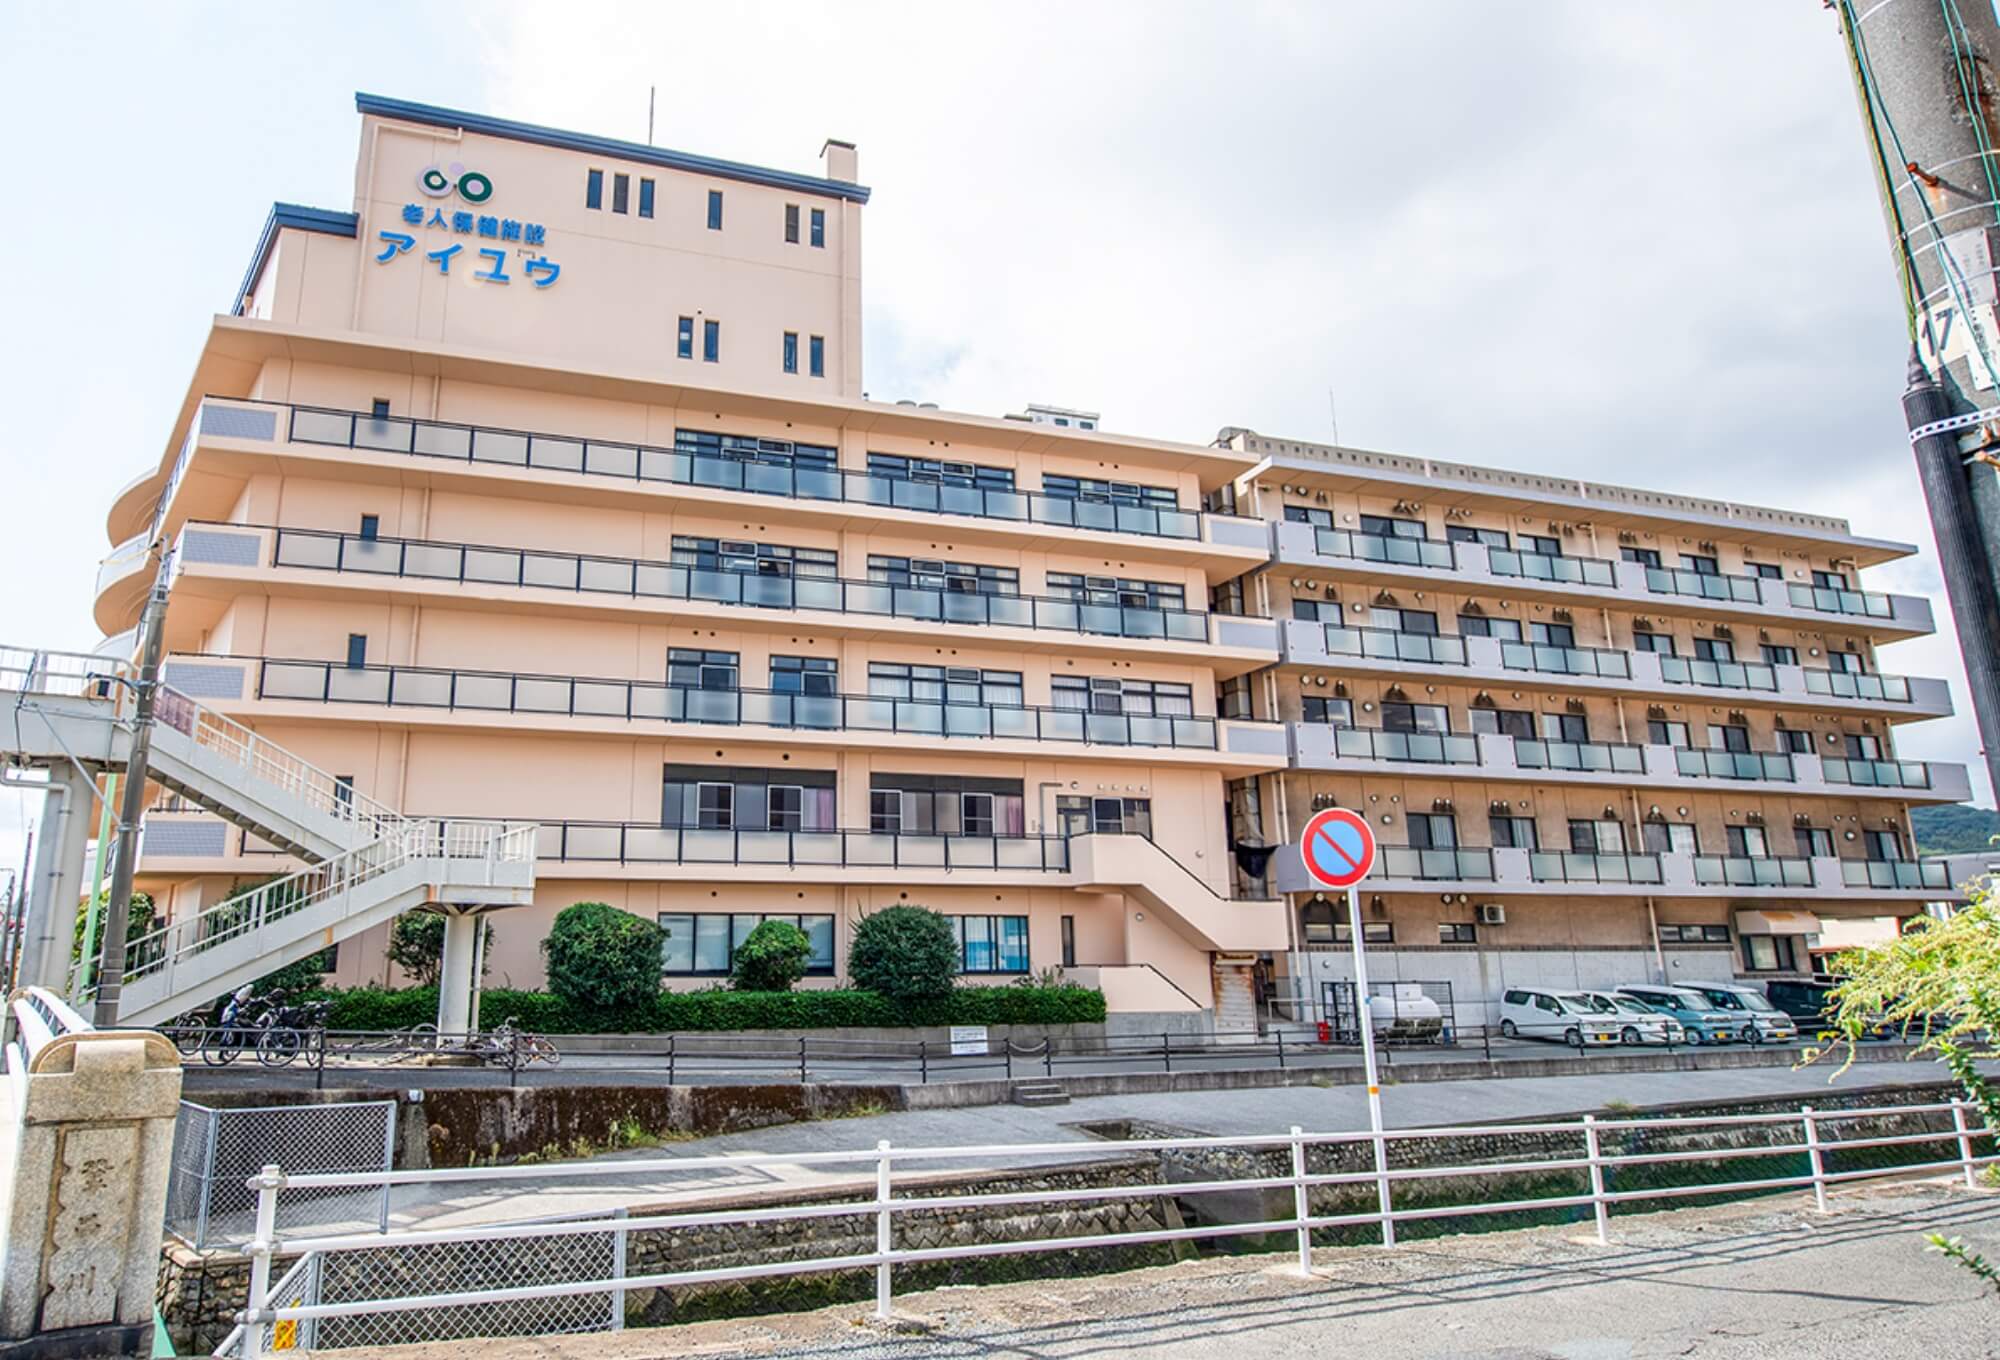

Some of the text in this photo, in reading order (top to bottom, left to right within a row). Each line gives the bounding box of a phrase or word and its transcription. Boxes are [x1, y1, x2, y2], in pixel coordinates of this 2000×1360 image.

[402, 204, 546, 246] 老人保健施設
[376, 231, 561, 288] アイユウ
